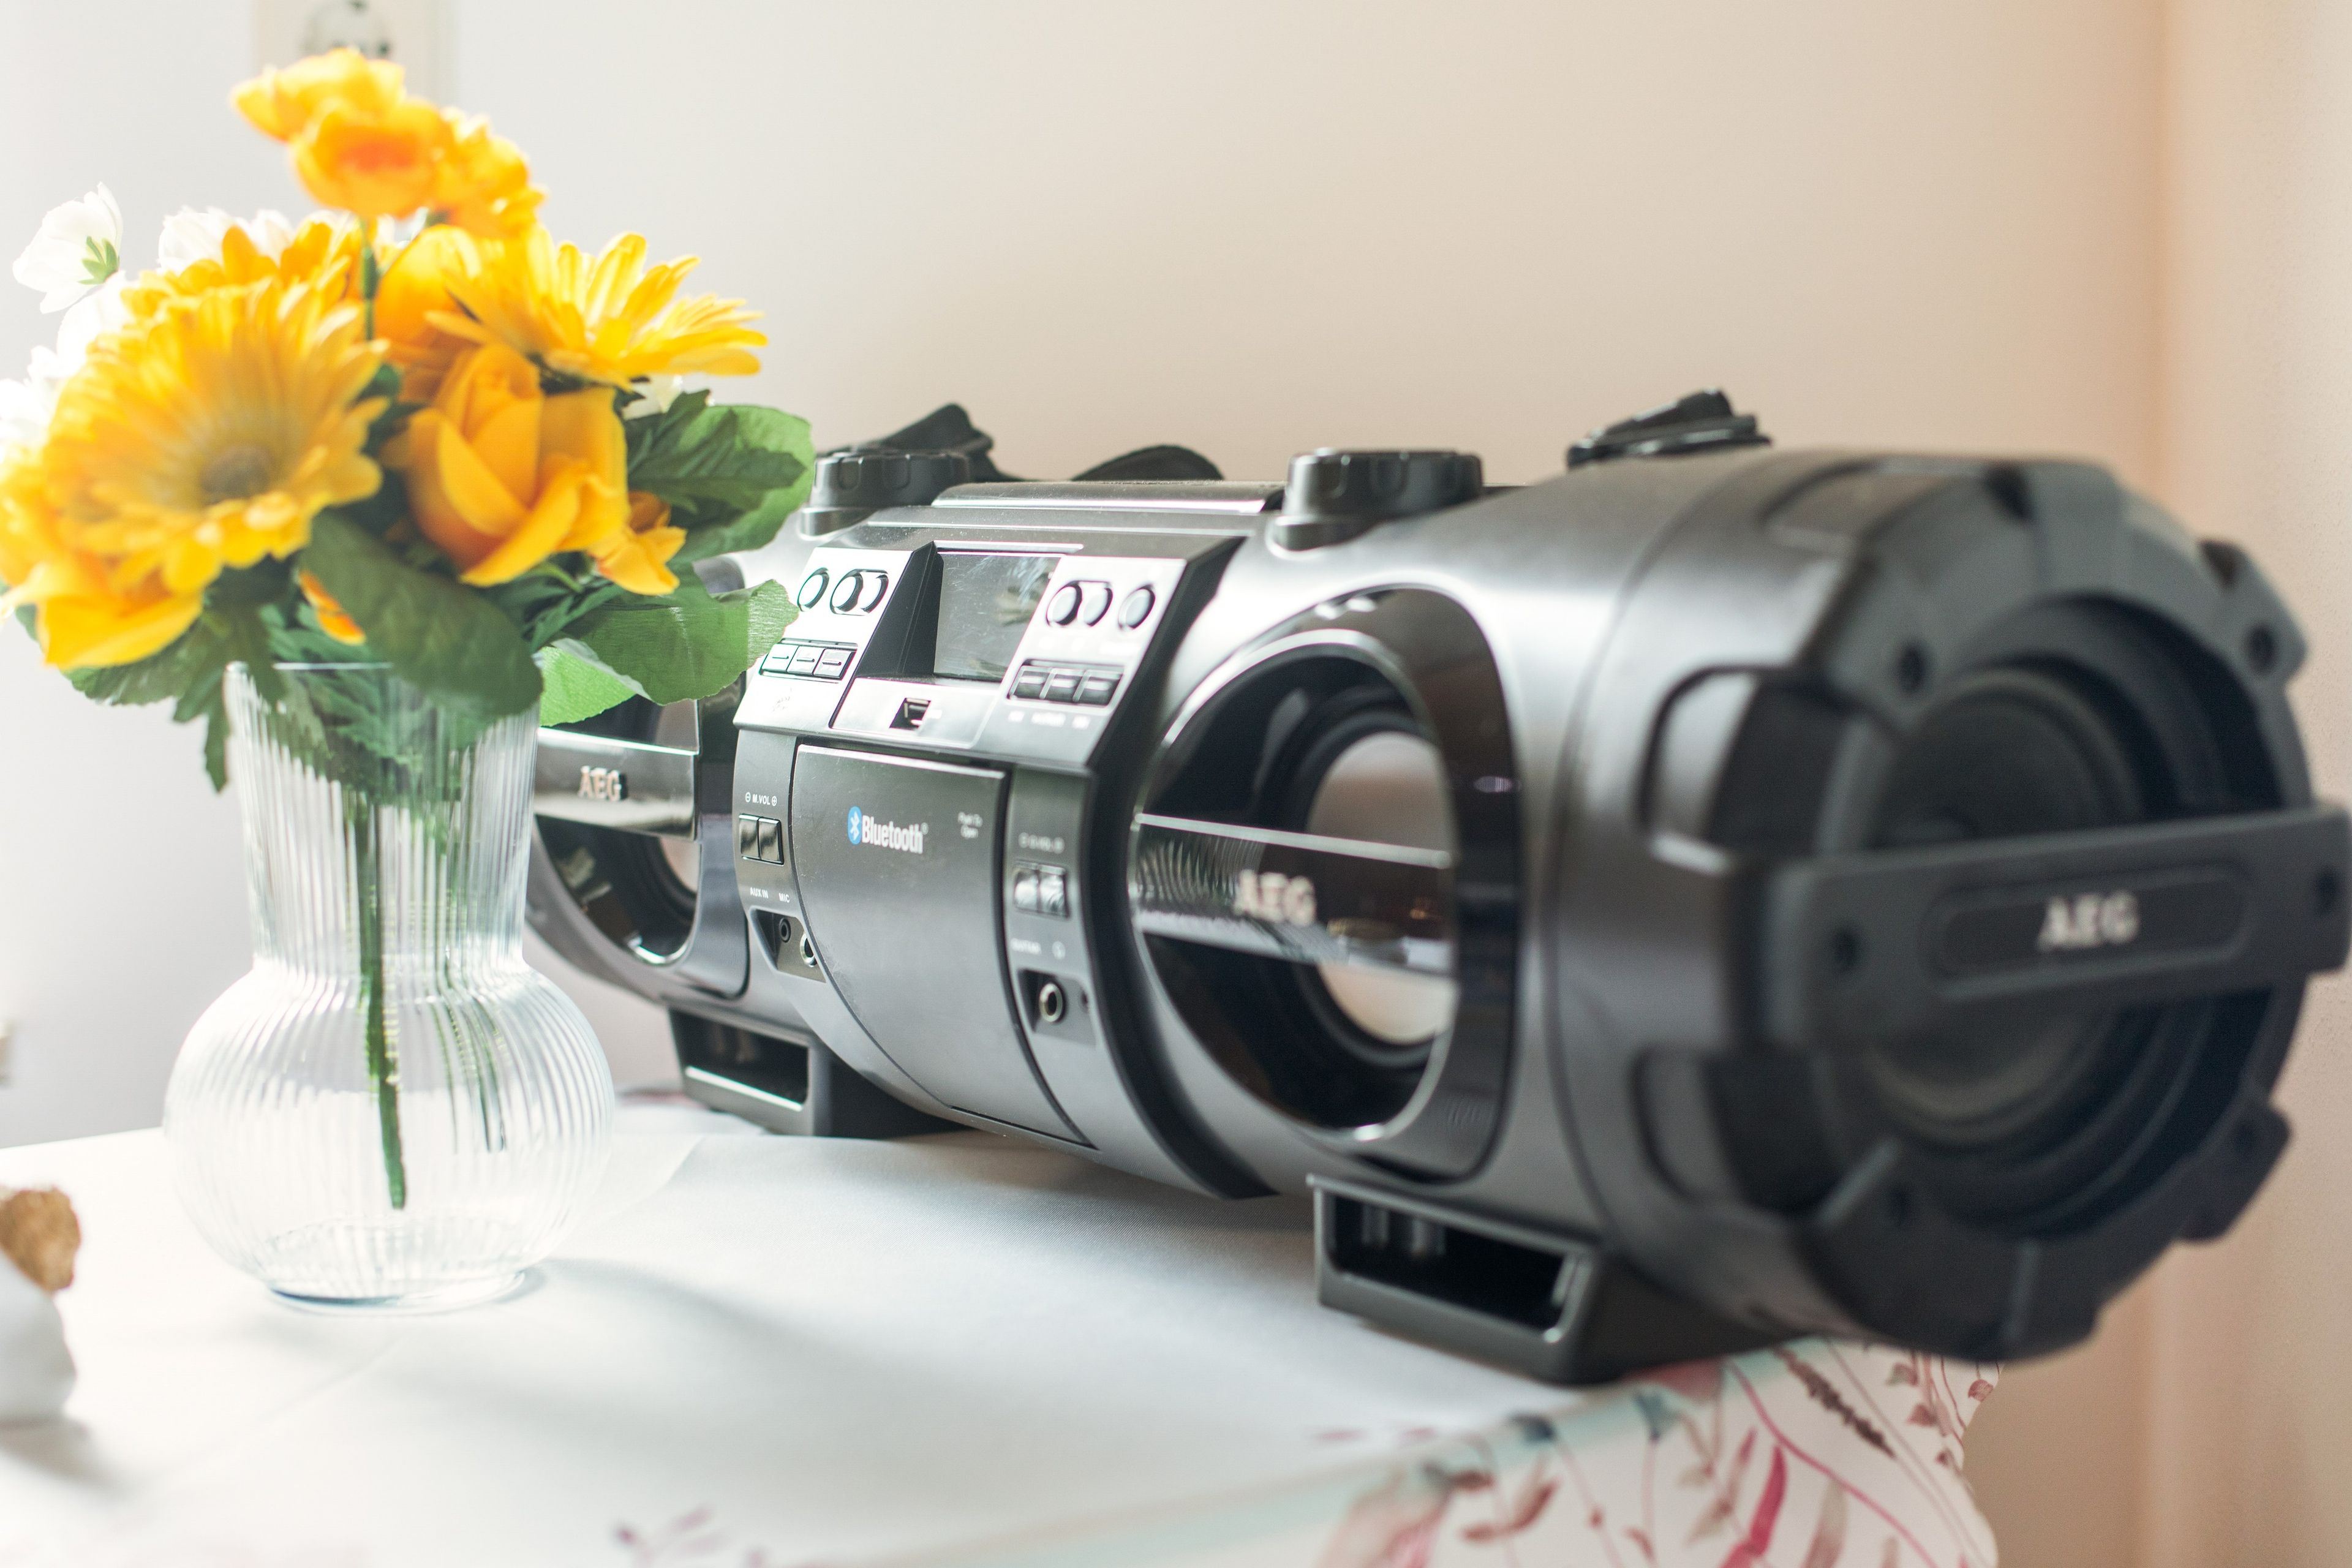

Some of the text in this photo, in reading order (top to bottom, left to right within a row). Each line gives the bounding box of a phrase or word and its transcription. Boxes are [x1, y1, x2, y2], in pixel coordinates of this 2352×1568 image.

[578, 766, 622, 801] AEG
[752, 793, 771, 805] M.VOL
[750, 887, 762, 897] AUX
[778, 892, 790, 903] MIC
[1233, 869, 1316, 927] AEG
[2037, 892, 2141, 951] AEG
